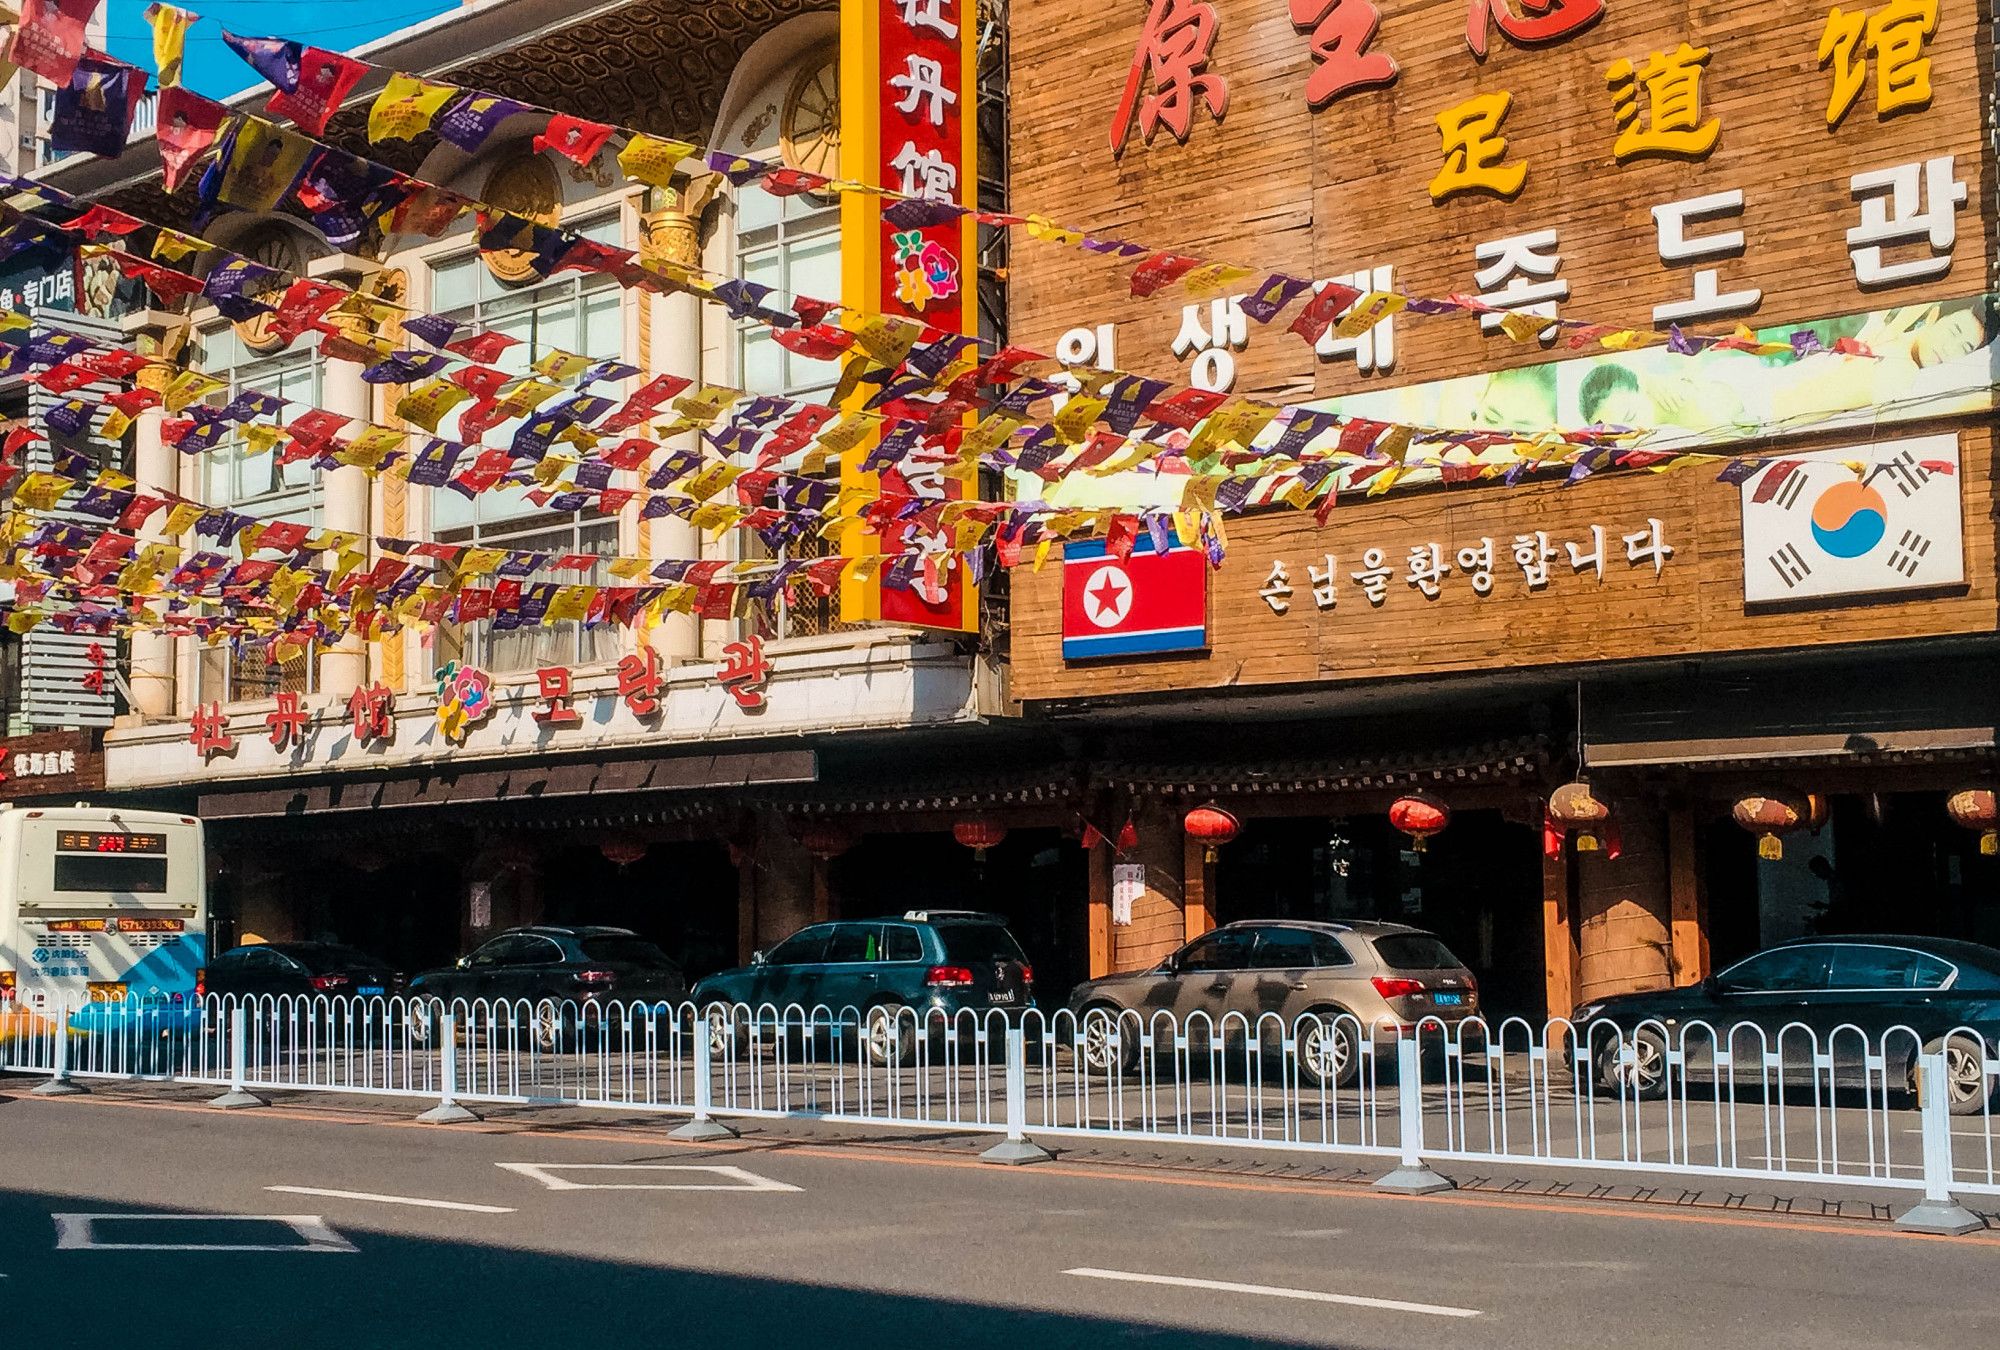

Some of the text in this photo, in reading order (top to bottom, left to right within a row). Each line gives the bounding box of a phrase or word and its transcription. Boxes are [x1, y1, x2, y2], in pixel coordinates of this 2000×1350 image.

[1429, 0, 1939, 200] 足道馆
[190, 681, 394, 758] 牡丹馆
[532, 635, 772, 723] 모란관
